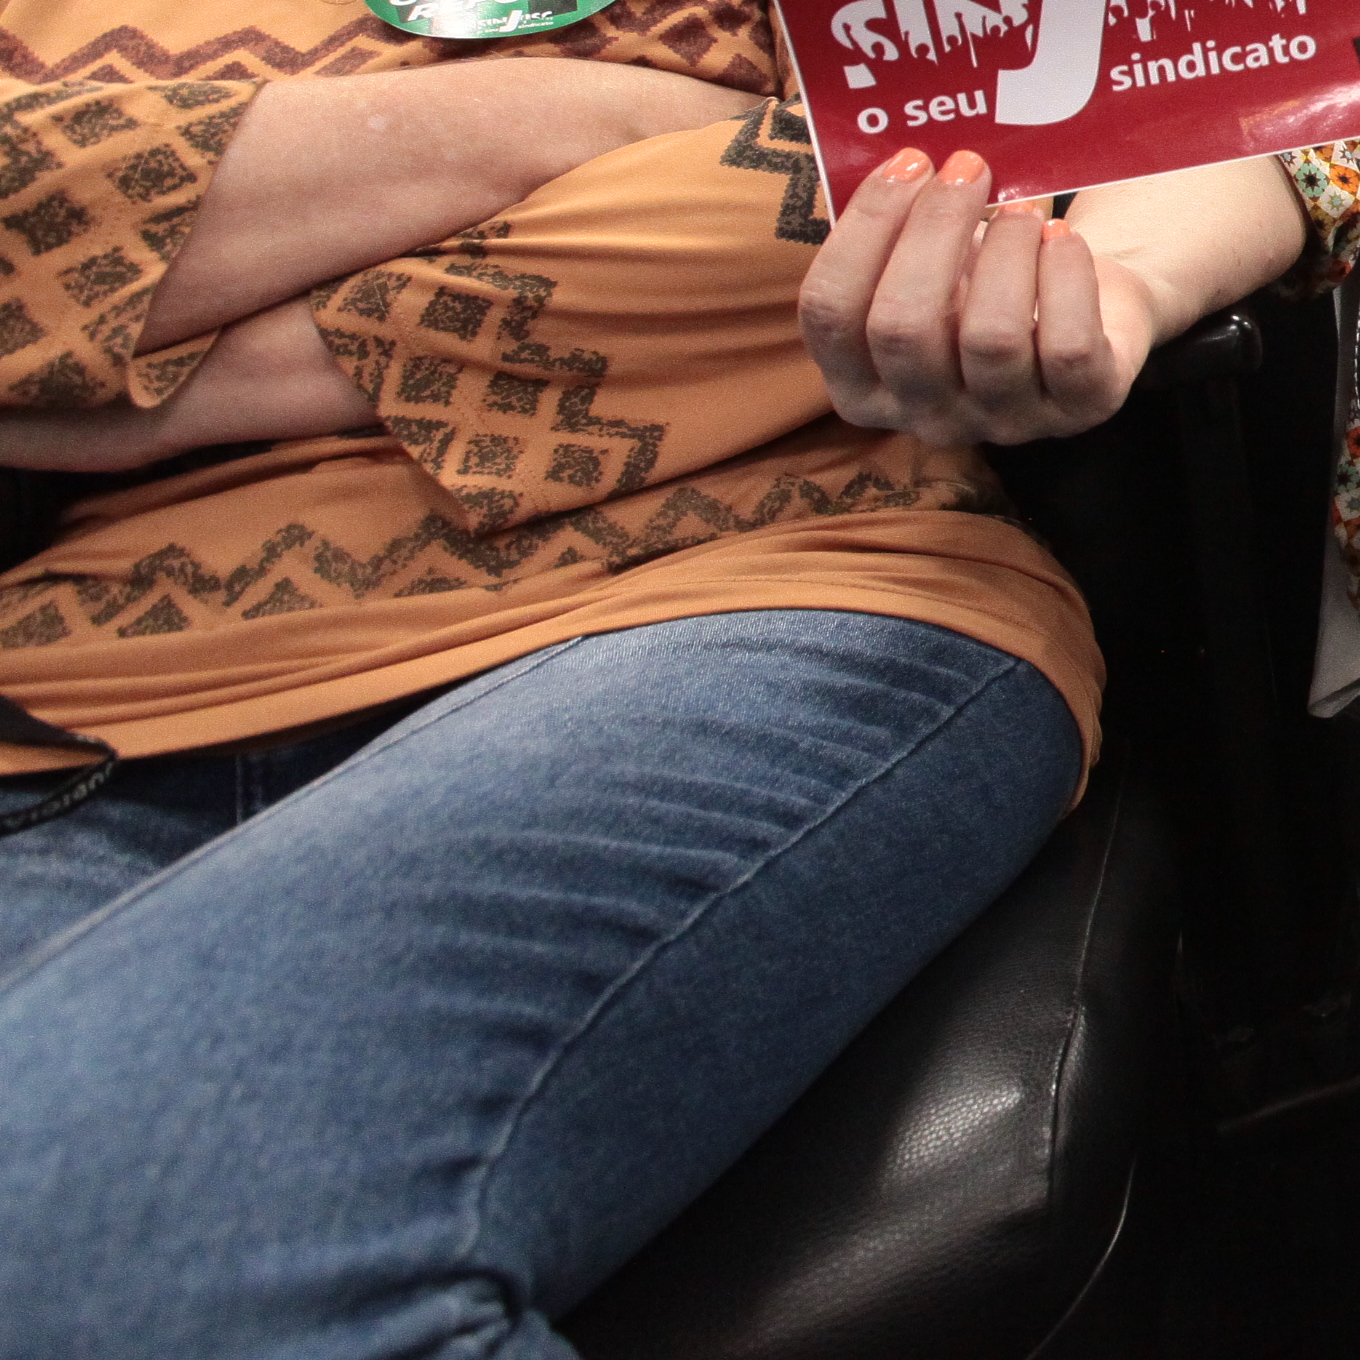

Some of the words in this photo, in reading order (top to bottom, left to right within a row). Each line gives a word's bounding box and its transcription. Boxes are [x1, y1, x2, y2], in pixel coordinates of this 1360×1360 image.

[857, 104, 888, 134] o
[903, 87, 988, 128] seu
[1109, 30, 1317, 92] sindicato
